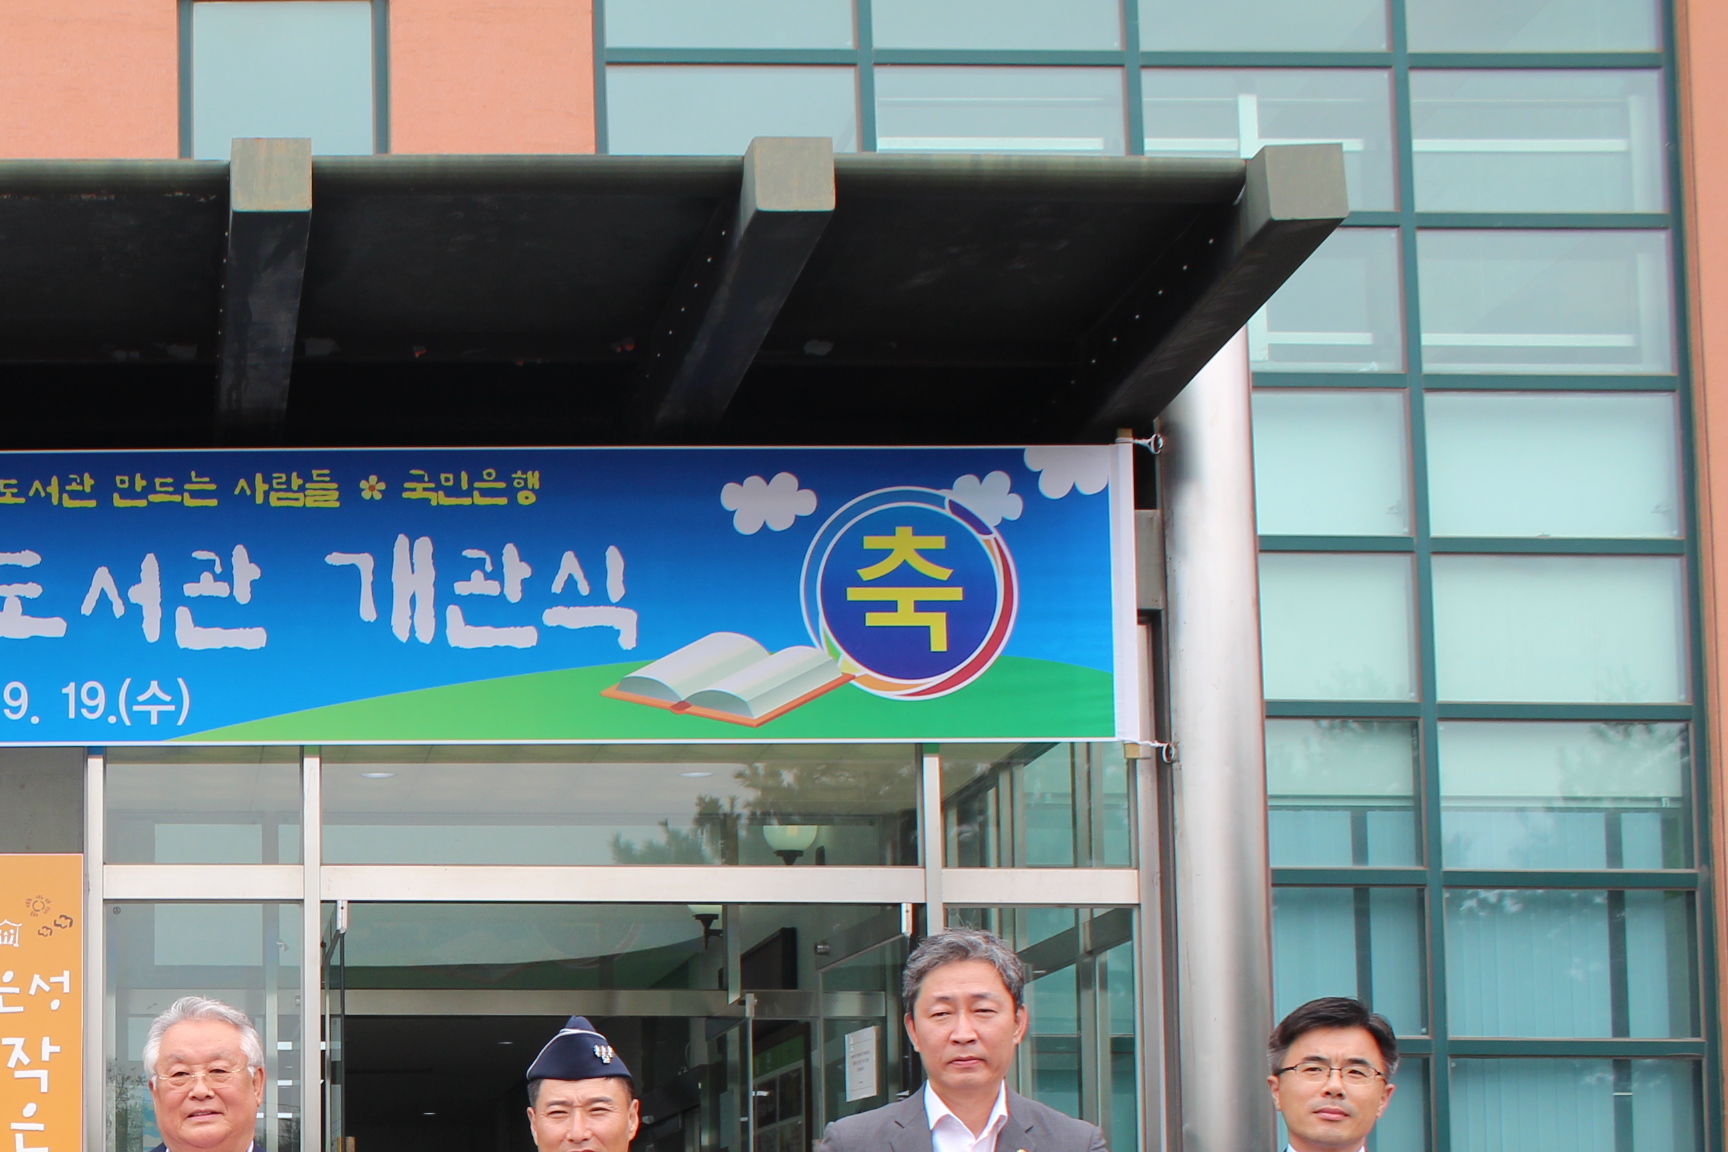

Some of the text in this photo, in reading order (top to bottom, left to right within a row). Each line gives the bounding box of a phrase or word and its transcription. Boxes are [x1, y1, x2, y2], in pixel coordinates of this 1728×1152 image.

[113, 470, 219, 507] 만드는
[234, 469, 341, 508] 사람들
[402, 468, 541, 506] 국민은행
[324, 533, 638, 651] 개관식
[846, 525, 964, 653] 축
[2, 680, 40, 724] 9.
[60, 677, 191, 726] 19.(수)
